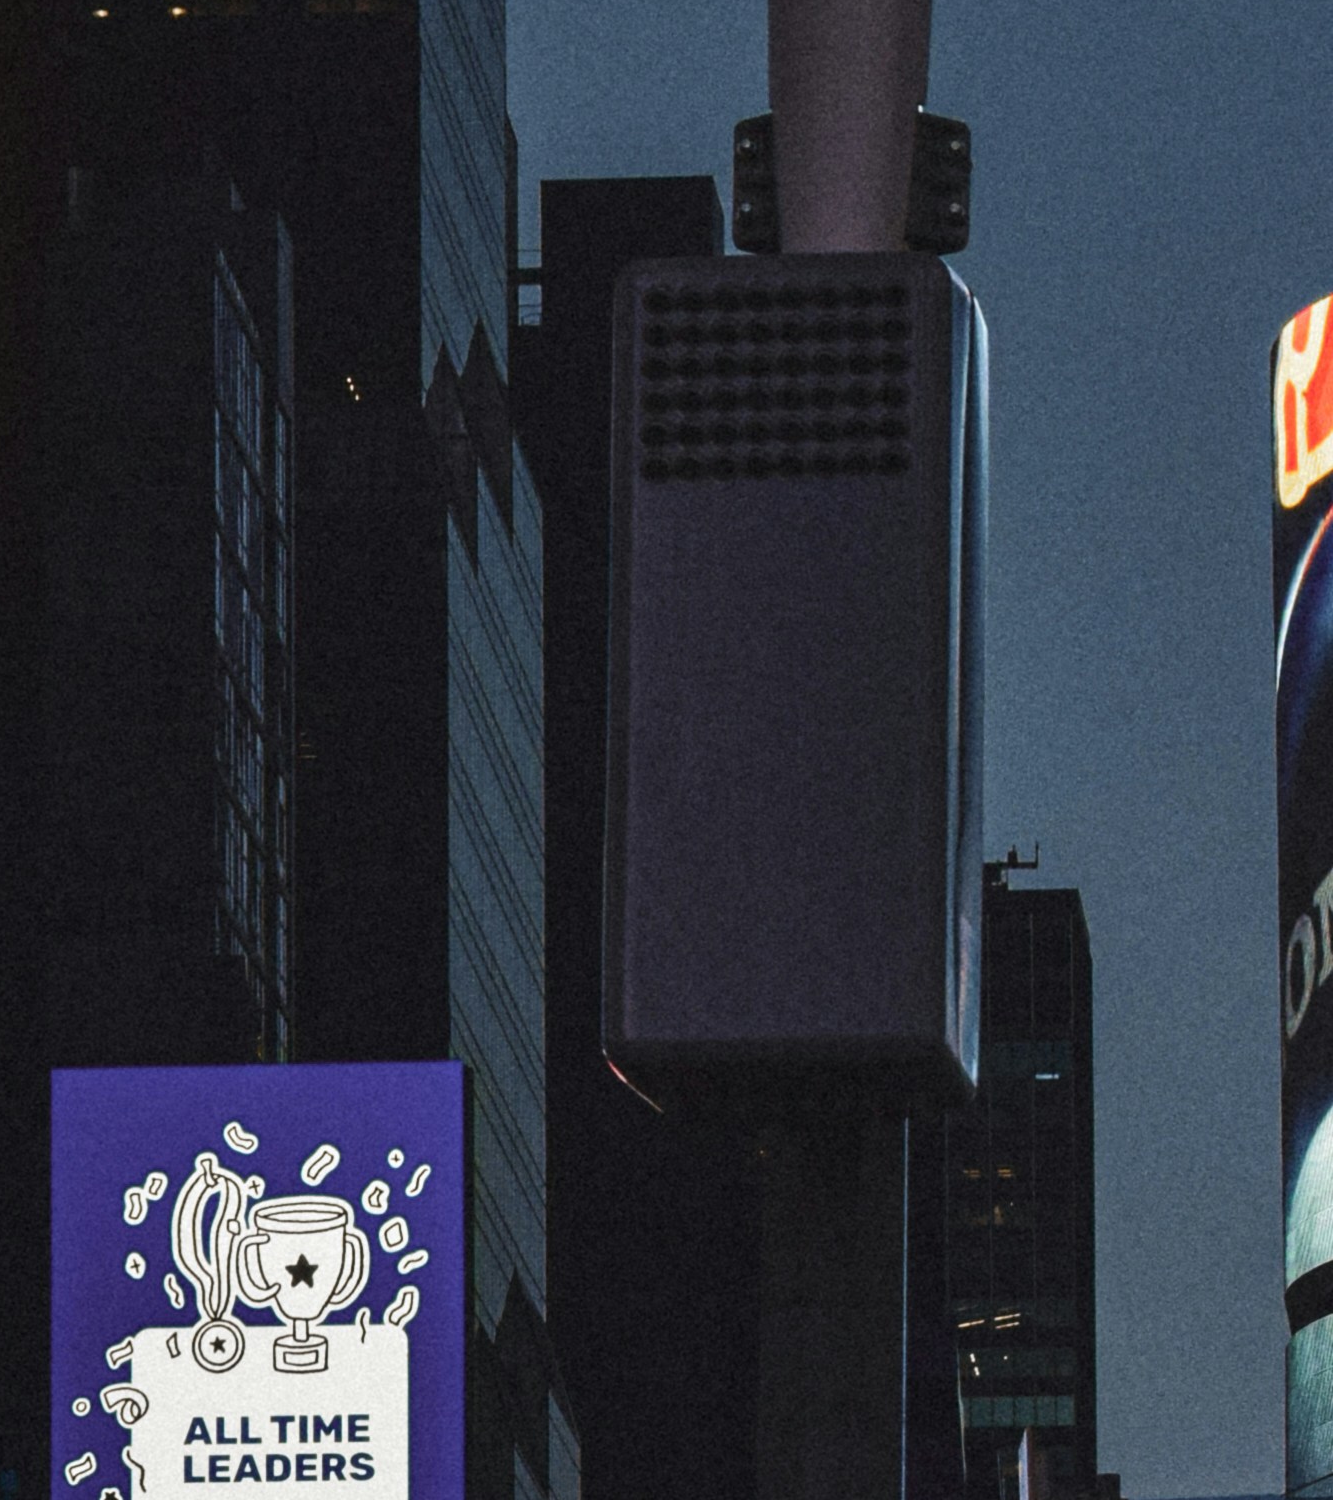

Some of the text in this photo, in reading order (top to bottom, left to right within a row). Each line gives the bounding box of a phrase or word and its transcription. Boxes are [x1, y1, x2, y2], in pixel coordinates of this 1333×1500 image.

[184, 1414, 371, 1445] ALL TIME
[183, 1451, 375, 1484] LEADERS
